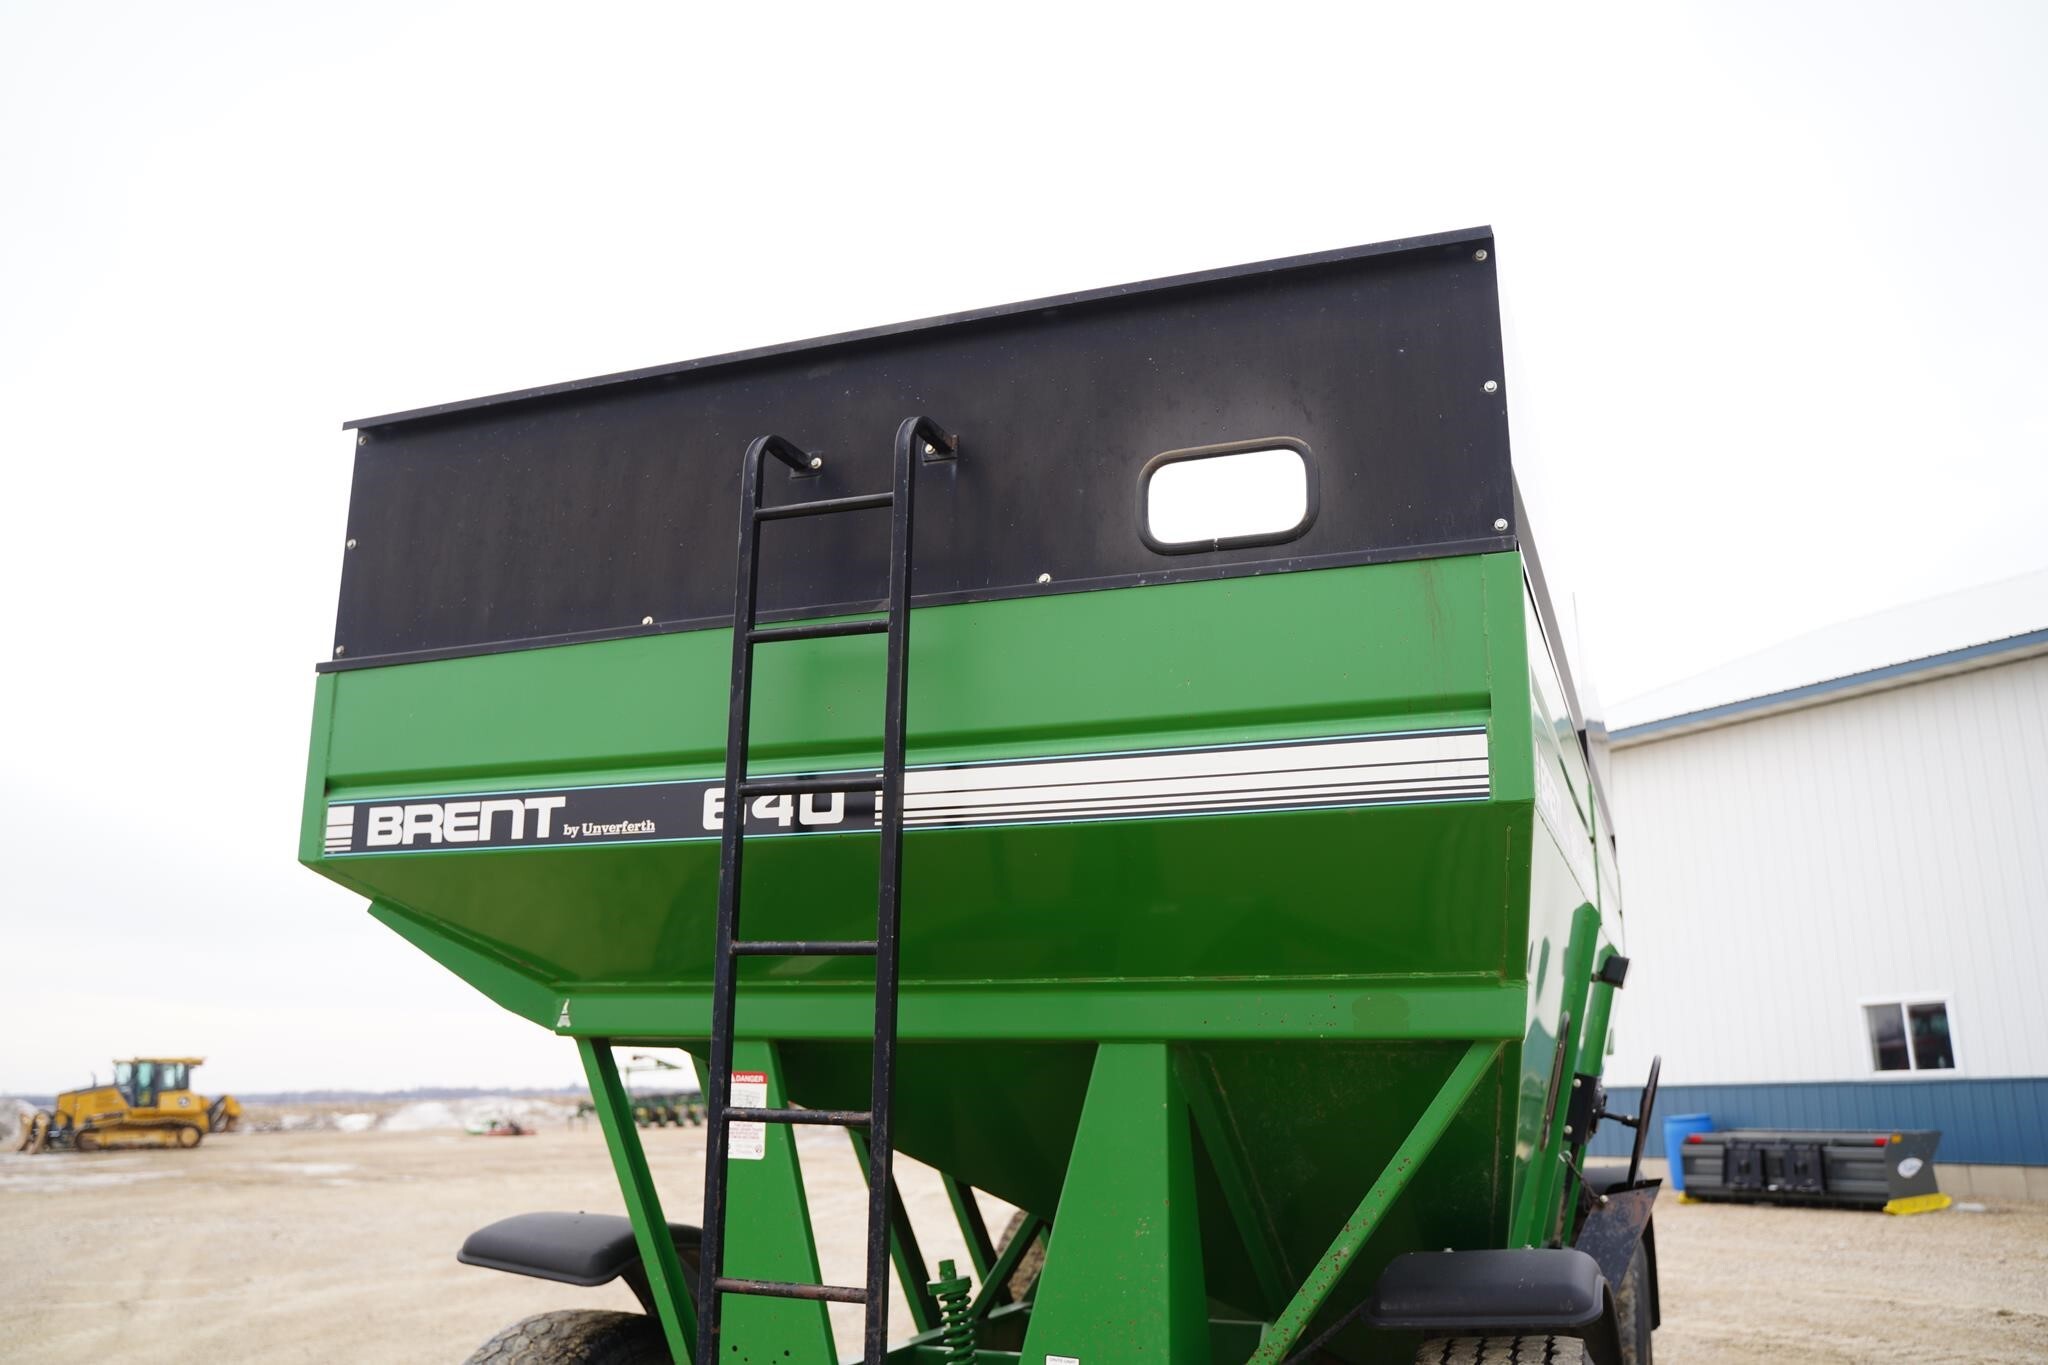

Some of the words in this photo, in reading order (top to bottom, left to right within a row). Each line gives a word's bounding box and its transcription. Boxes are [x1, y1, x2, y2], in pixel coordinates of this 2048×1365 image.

[368, 796, 566, 846] BRENT
[563, 824, 579, 838] by
[582, 820, 655, 836] Unverferth
[735, 1075, 764, 1083] DANGER
